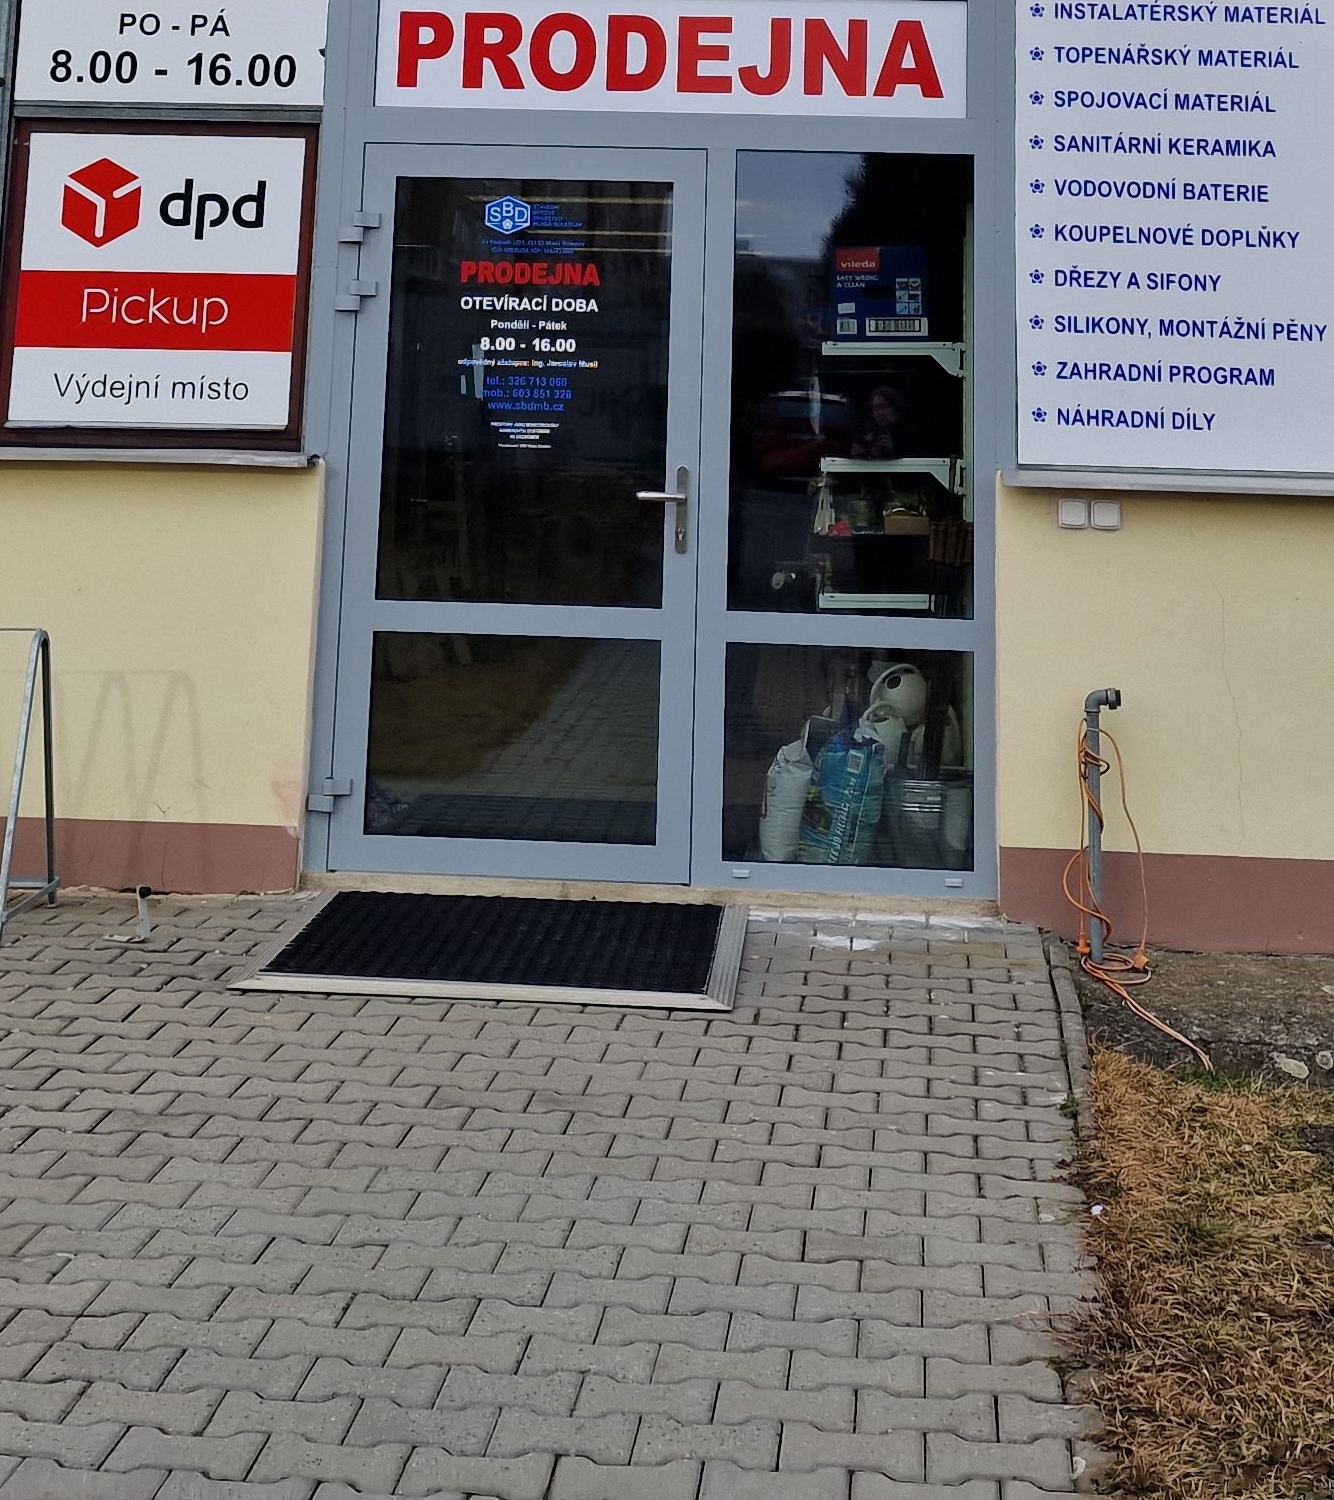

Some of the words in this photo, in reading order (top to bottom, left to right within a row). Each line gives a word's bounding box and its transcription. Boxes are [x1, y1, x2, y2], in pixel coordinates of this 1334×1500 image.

[119, 13, 160, 35] PO
[191, 9, 230, 36] PÁ
[1055, 0, 1217, 22] INSTALATÉRSKÝ
[1225, 3, 1325, 24] MATERIÁL
[397, 11, 944, 98] PRODEJNA
[1054, 43, 1191, 65] TOPENÁŘSKÝ
[1199, 47, 1299, 68] MATERIÁL
[50, 50, 137, 83] 8.00
[188, 53, 296, 87] 16.00
[1054, 88, 1167, 109] SPOJOVACÍ
[1175, 91, 1276, 112] MATERIÁL
[1054, 132, 1161, 154] SANITÁRNÍ
[1169, 138, 1276, 157] KERAMIKA
[1054, 178, 1176, 199] VODOVODNÍ
[1184, 183, 1269, 202] BATERIE
[160, 179, 266, 240] dpd
[489, 201, 527, 222] SBD
[1055, 223, 1194, 245] KOUPELNOVÉ
[1202, 226, 1299, 248] DOPLŇKY
[460, 261, 600, 286] PRODEJNA
[841, 258, 875, 268] vileda
[1055, 265, 1121, 288] DŘEZY
[1127, 272, 1140, 289] A
[1147, 273, 1221, 292] SIFONY
[81, 287, 228, 333] Pickup
[460, 294, 547, 311] OTEVÍRACÍ
[551, 299, 598, 312] DOBA
[538, 320, 567, 331] Pátek
[1054, 315, 1151, 339] SILIKONY,
[1160, 316, 1265, 339] MONTÁŽNÍ
[1273, 319, 1327, 341] PĚNY
[480, 337, 516, 351] 8.00
[532, 338, 576, 352] 16.00
[1057, 360, 1161, 382] ZAHRADNÍ
[1170, 365, 1274, 386] PROGRAM
[54, 373, 160, 405] Výdejní
[172, 375, 248, 400] místo
[1058, 404, 1164, 429] NÁHRADNÍ
[1173, 408, 1215, 430] DÍLY
